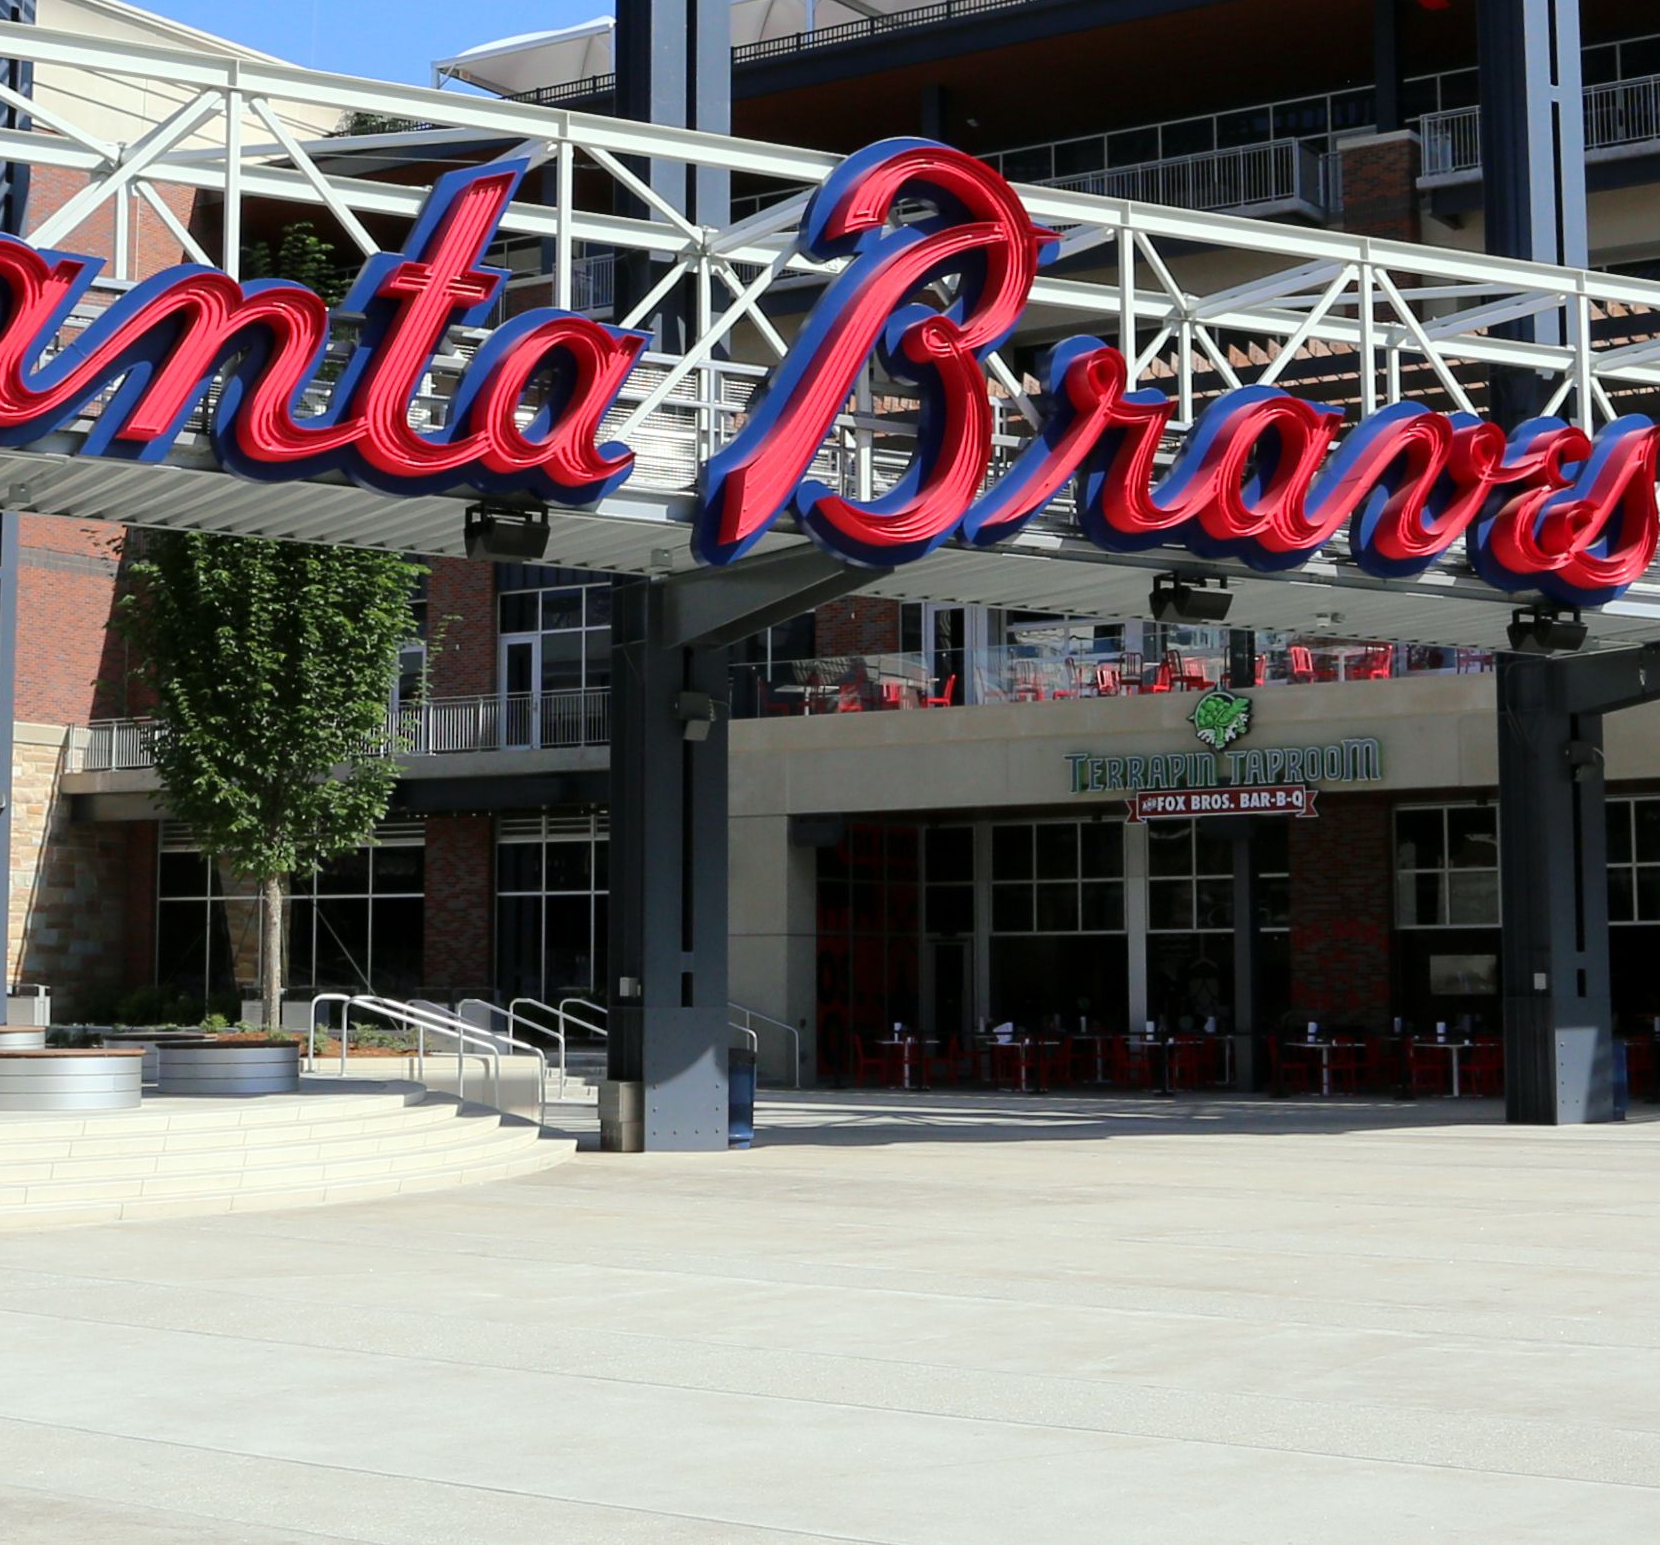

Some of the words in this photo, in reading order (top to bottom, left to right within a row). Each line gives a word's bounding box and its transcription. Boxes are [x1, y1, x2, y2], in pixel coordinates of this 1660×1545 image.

[1063, 751, 1217, 795] TERRAPIN
[1225, 738, 1382, 786] TAPROOM
[1157, 795, 1186, 811] FOX
[1190, 793, 1235, 810] BROS.
[1240, 791, 1303, 808] BAR-B-Q
